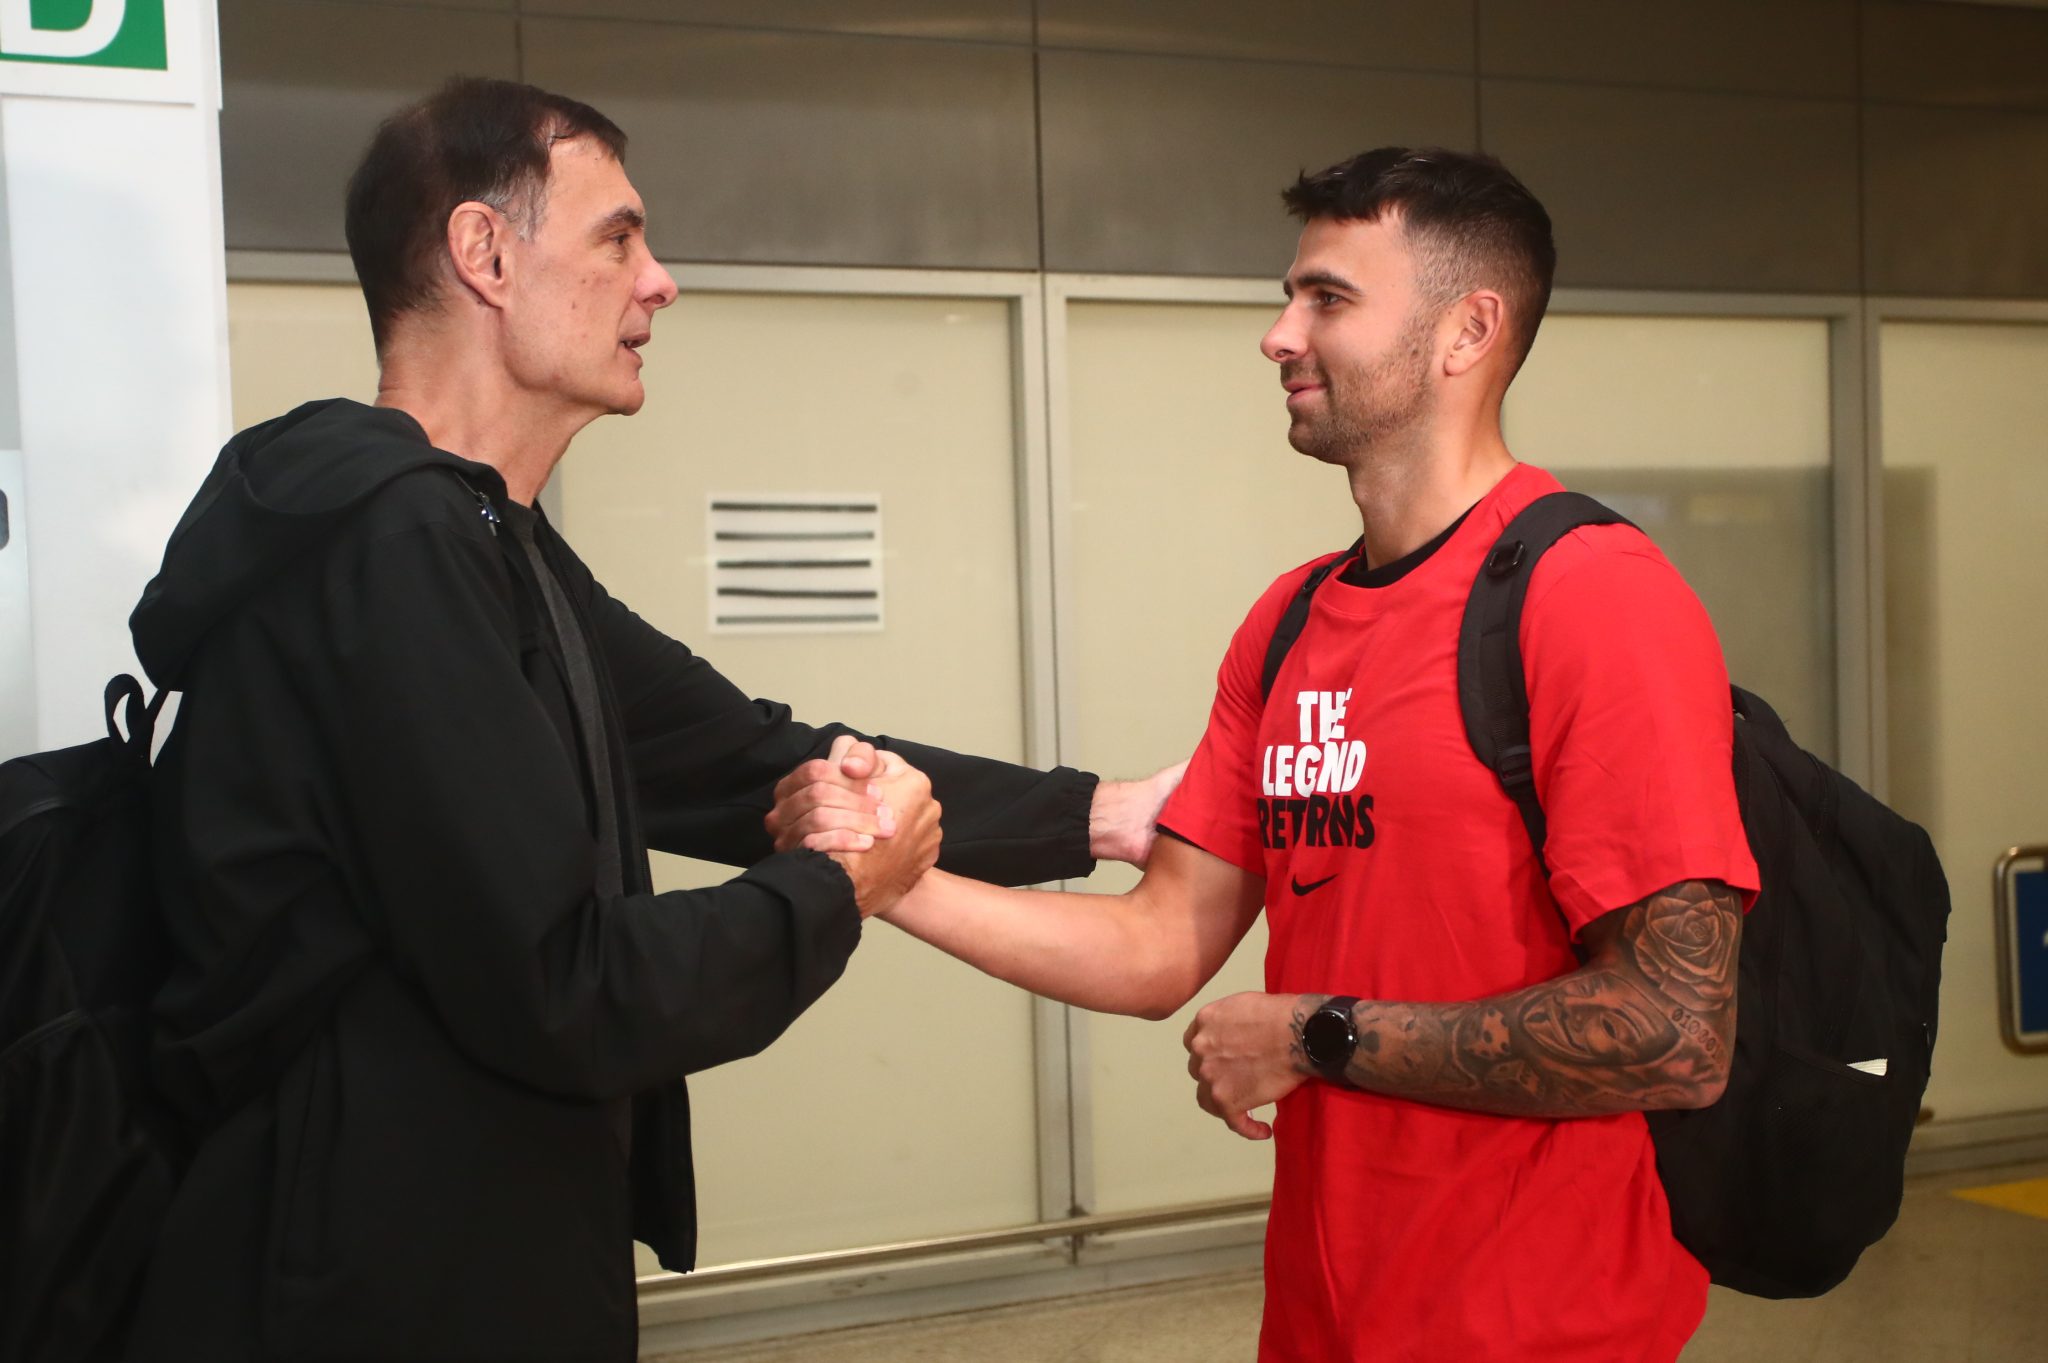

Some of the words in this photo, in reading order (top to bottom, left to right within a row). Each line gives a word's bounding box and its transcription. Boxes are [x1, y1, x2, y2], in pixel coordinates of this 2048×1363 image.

[1296, 688, 1352, 743] THE
[1263, 740, 1367, 797] LEGND
[1257, 794, 1375, 849] RETRNS
